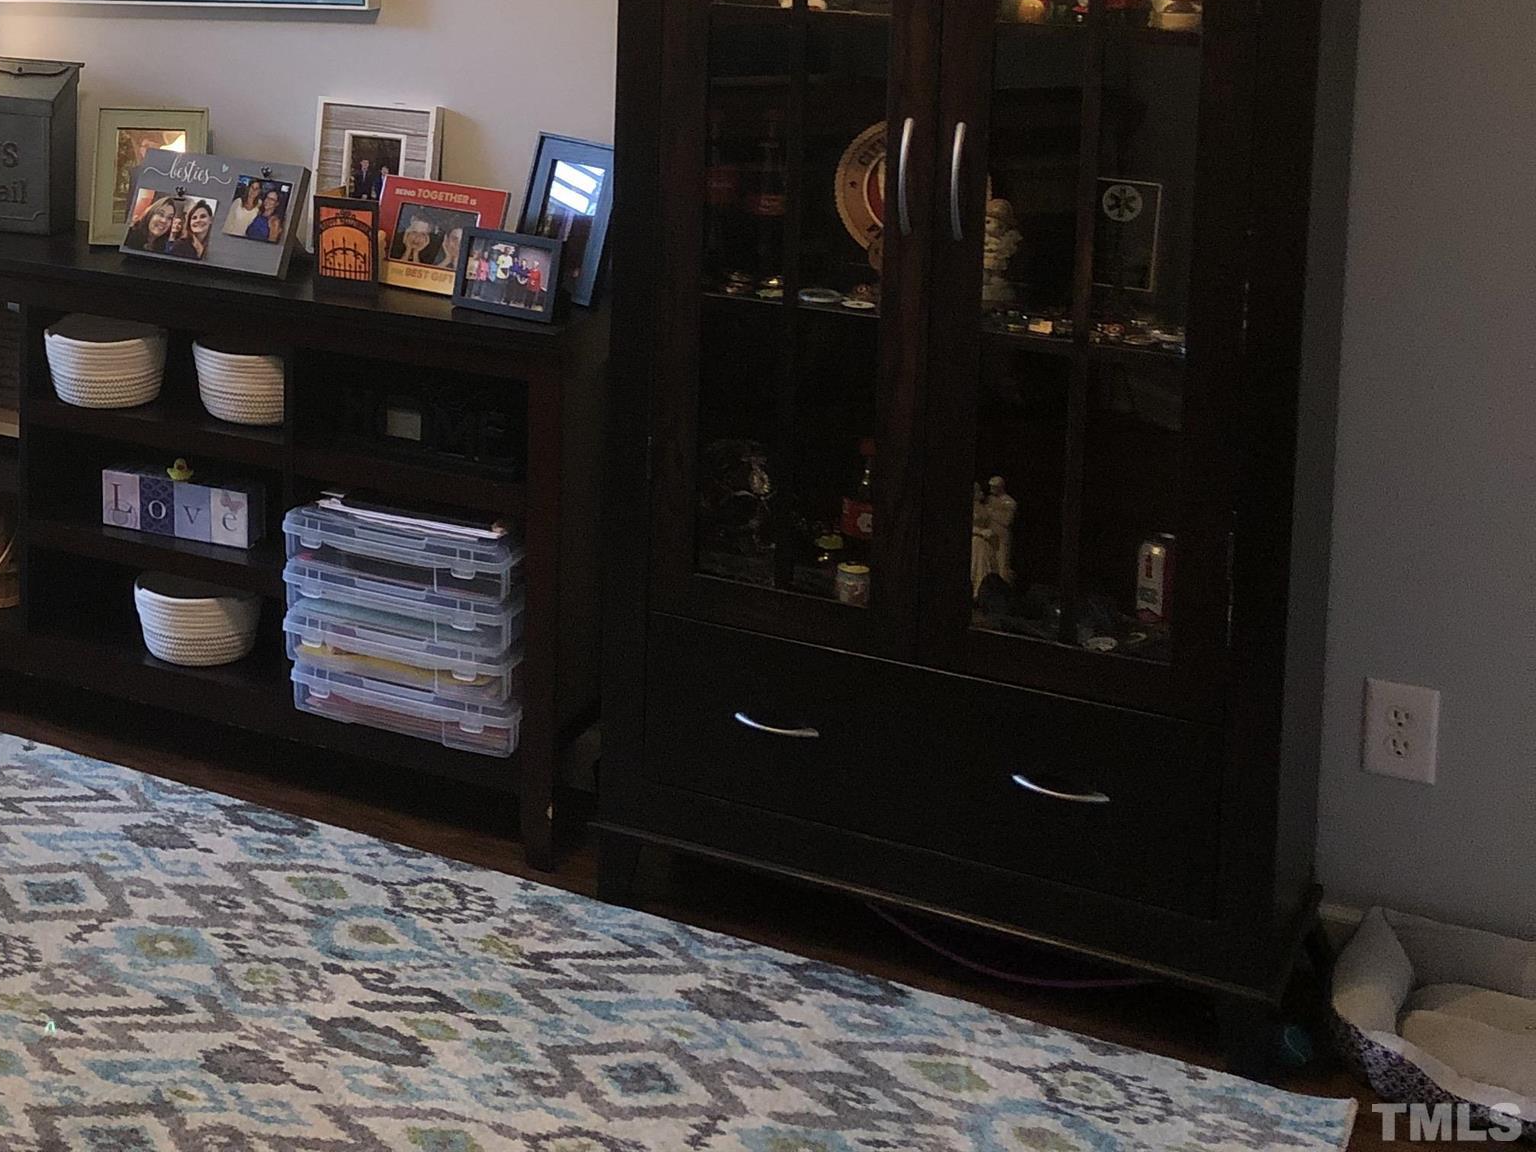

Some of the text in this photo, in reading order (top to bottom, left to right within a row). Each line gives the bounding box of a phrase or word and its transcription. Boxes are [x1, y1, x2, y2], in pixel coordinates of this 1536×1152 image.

[417, 189, 470, 206] TOGETHER
[405, 267, 429, 280] BEST
[431, 271, 454, 284] GIFT
[110, 482, 238, 532] Love
